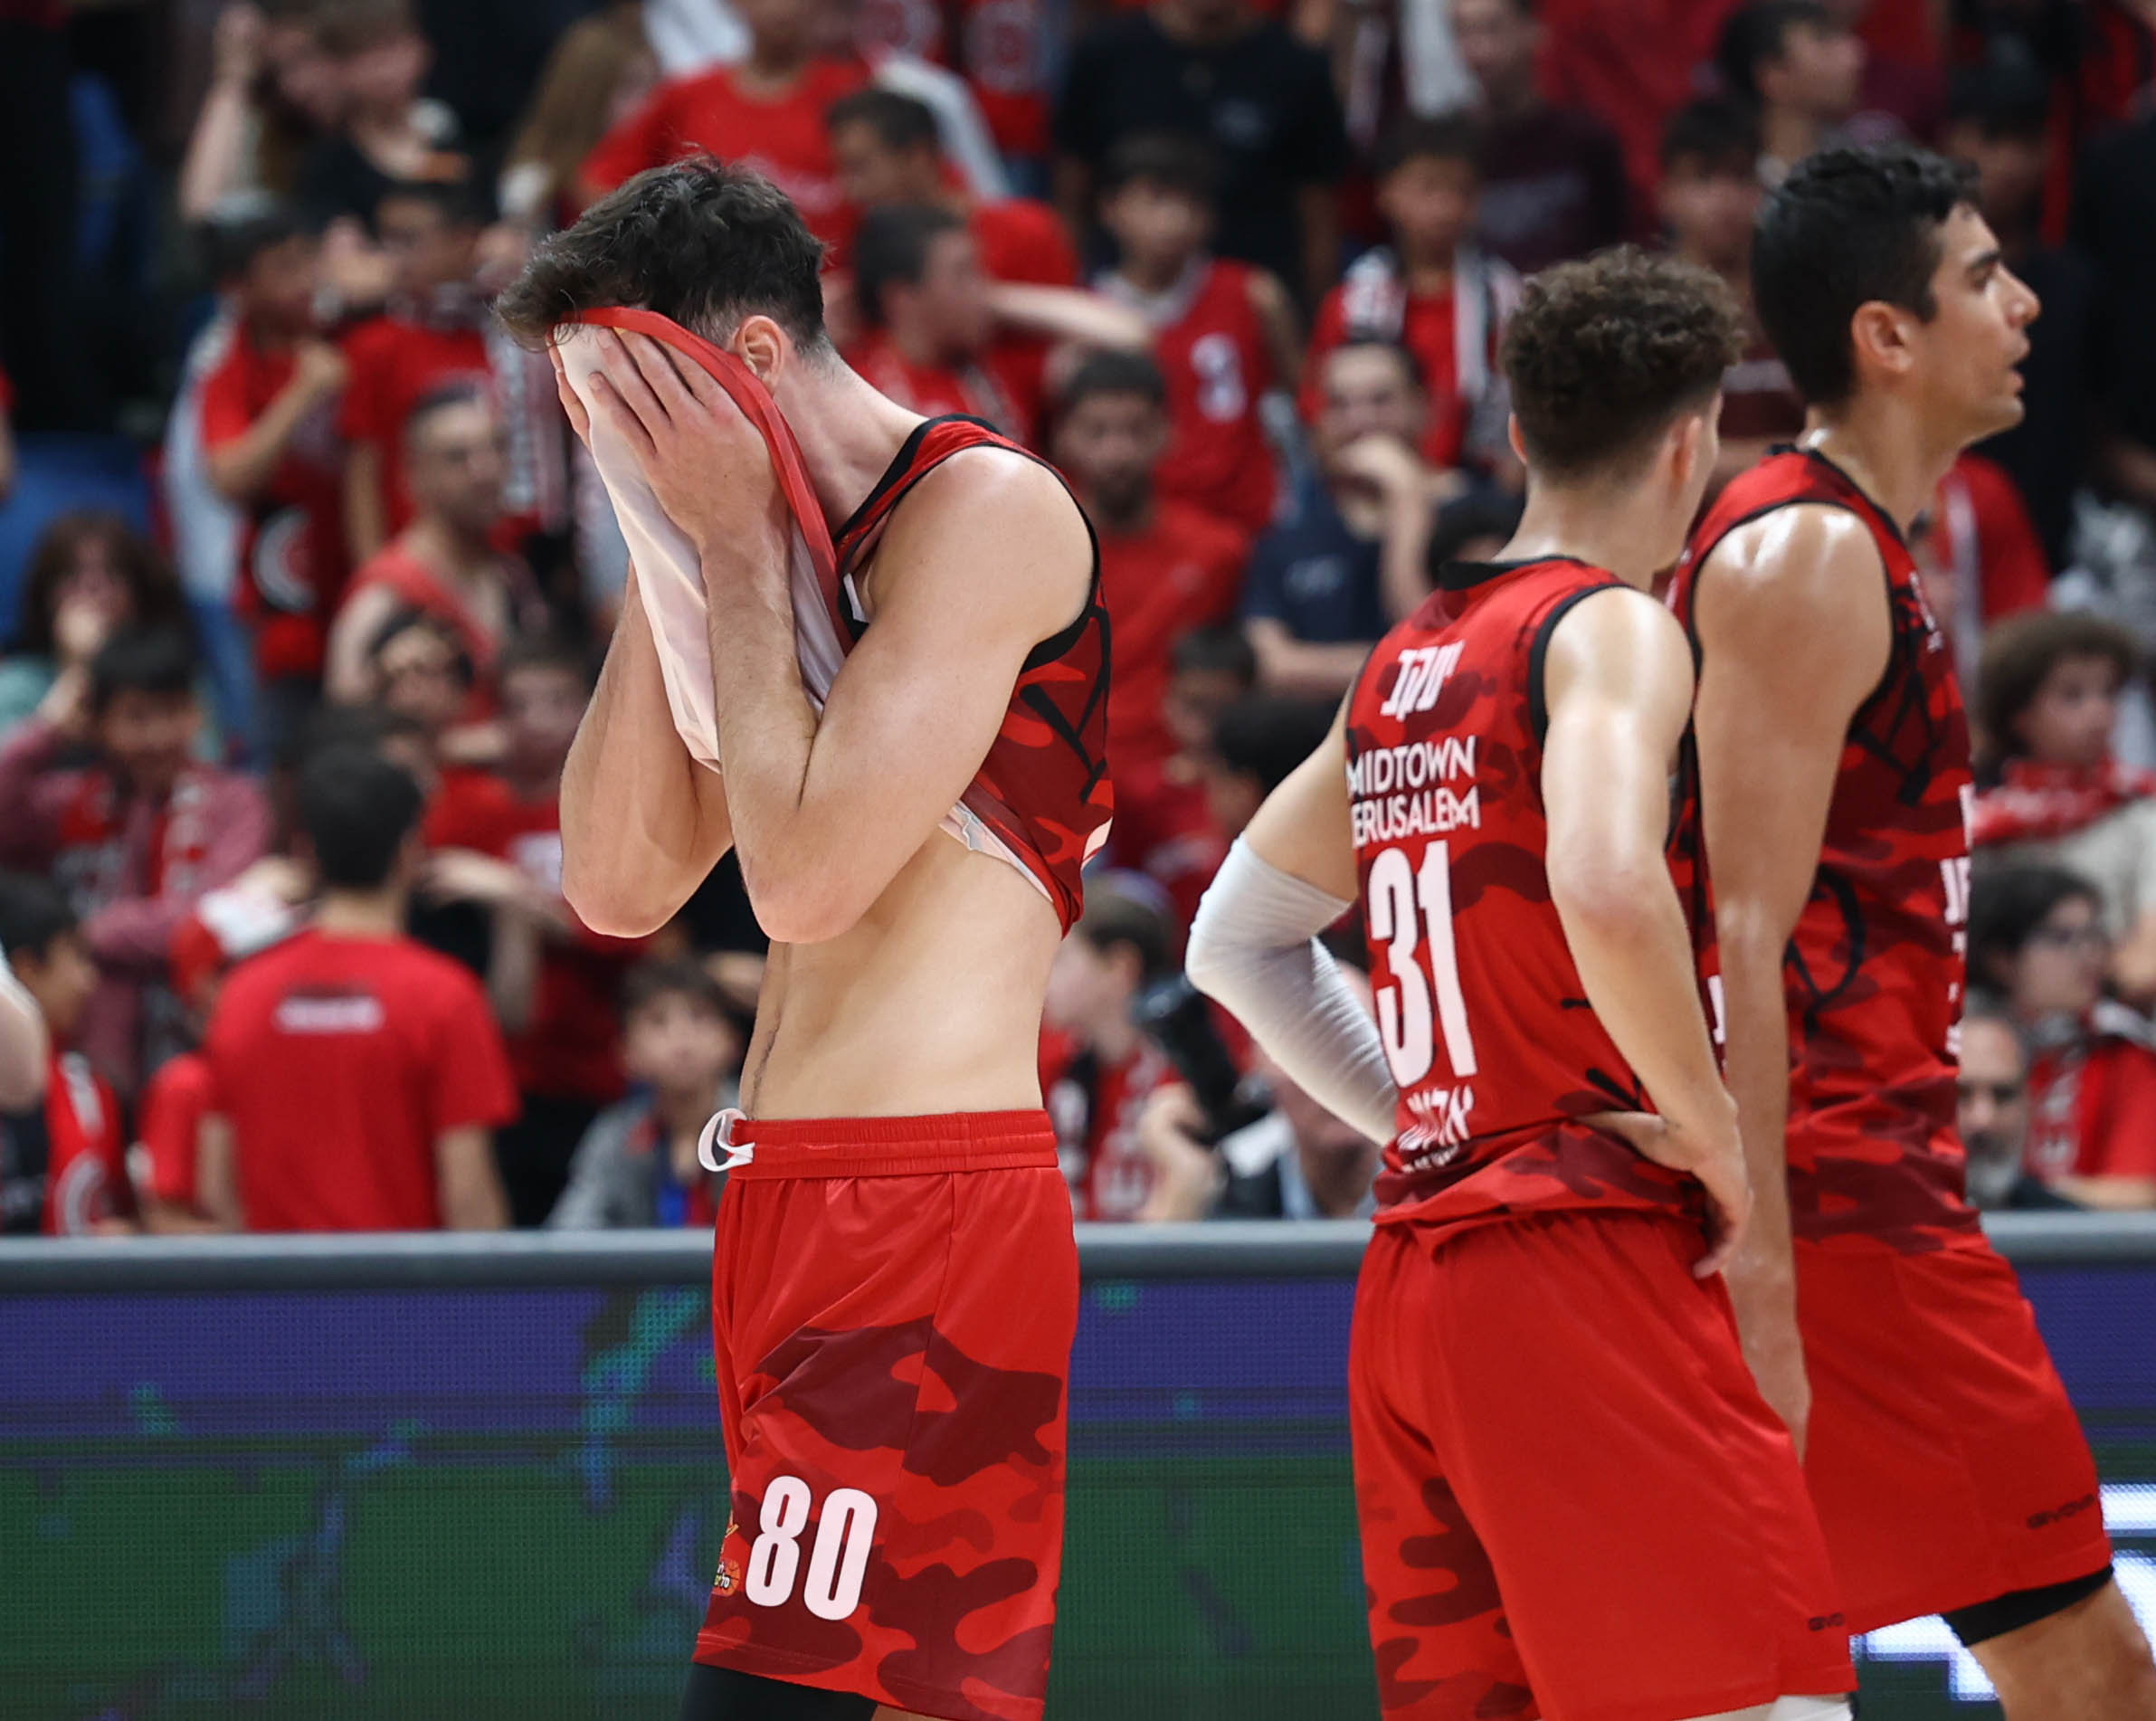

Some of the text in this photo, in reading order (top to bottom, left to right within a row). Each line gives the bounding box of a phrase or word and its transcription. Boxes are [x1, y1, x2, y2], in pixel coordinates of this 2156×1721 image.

[1346, 734, 1477, 799] MIDTOWN
[1350, 784, 1481, 849] ERUSALEM
[1368, 840, 1477, 1088] 31
[745, 1475, 878, 1621] 80
